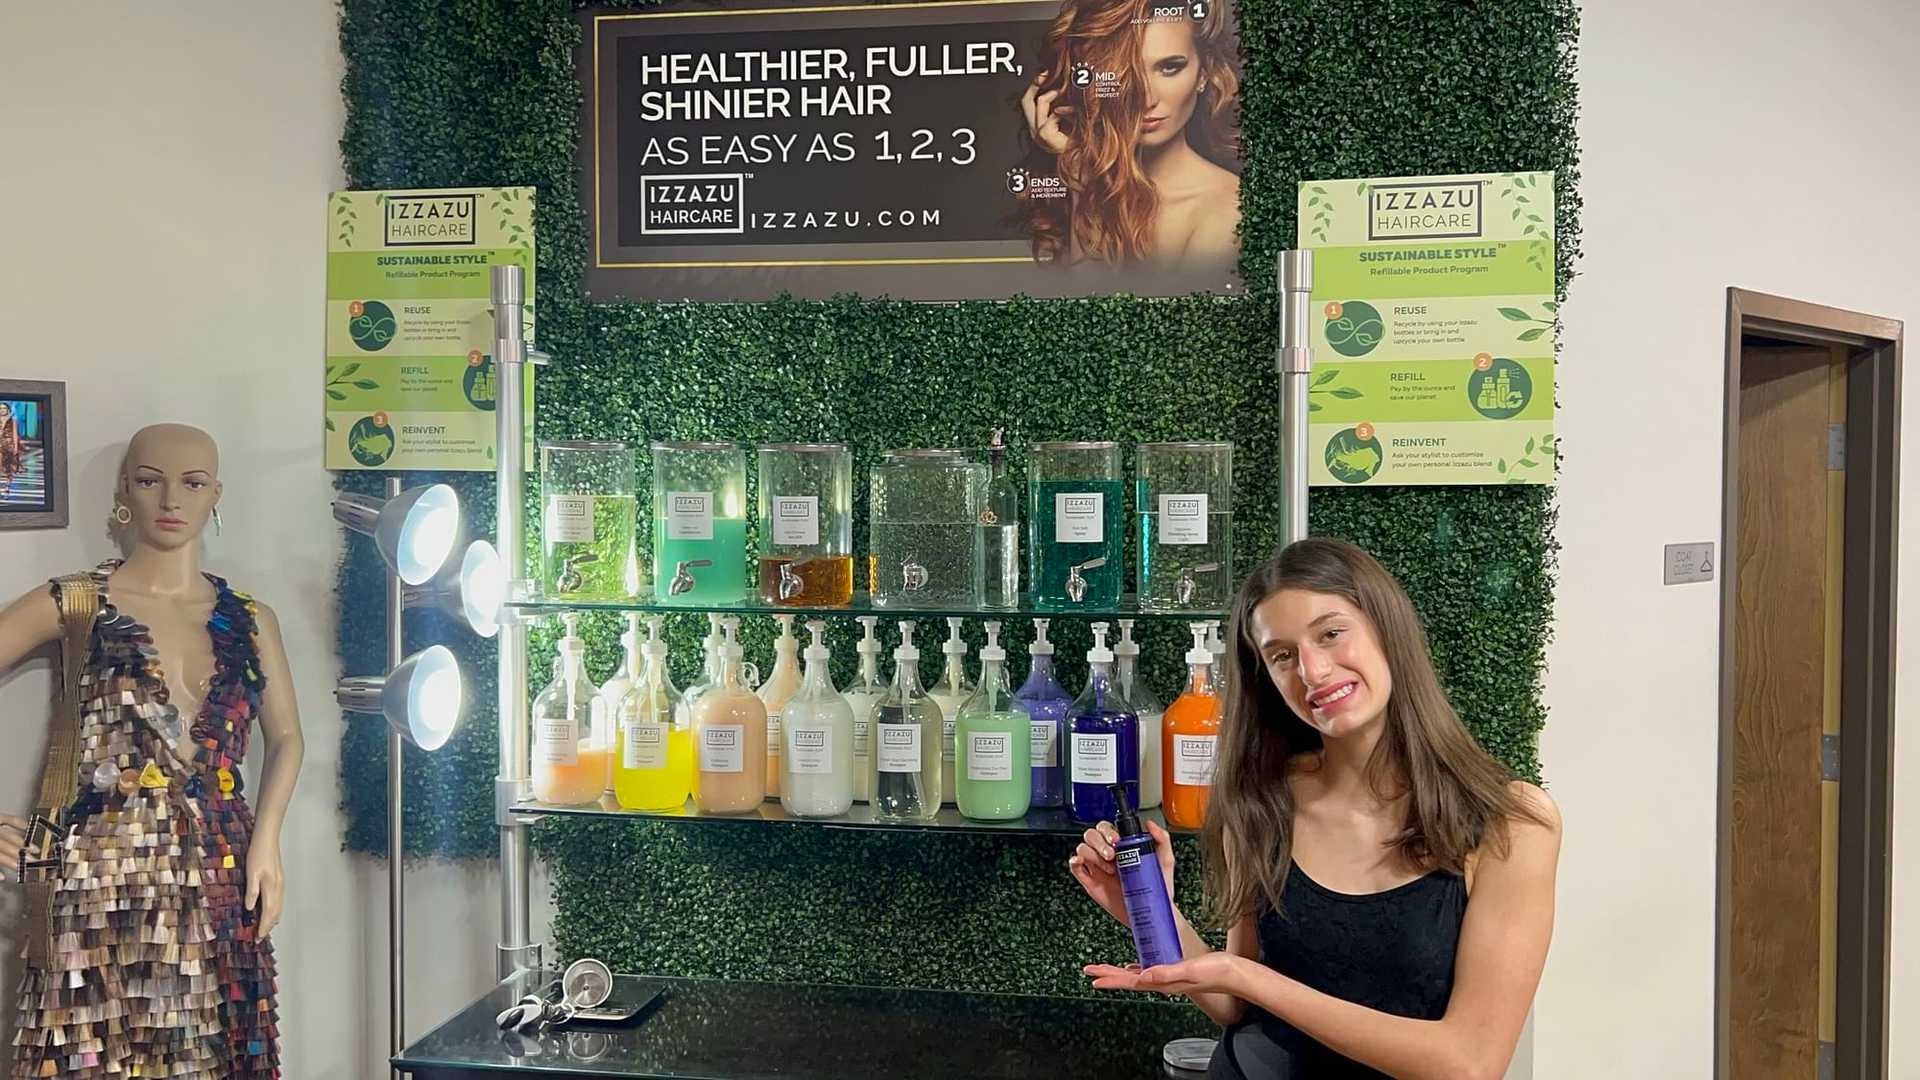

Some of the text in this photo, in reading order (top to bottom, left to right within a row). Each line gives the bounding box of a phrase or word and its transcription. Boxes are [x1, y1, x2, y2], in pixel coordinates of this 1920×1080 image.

[1154, 7, 1184, 17] ROOT
[1193, 3, 1205, 18] 1
[641, 42, 1023, 86] HEALTHIER, FULLER,
[1076, 69, 1116, 85] 2 MID
[641, 84, 892, 122] SHINIER HAIR
[640, 136, 689, 166] AS
[701, 133, 797, 164] EASY
[805, 132, 856, 163] AS
[1012, 174, 1060, 192] 3 ENDS
[650, 184, 734, 203] IZZAZU
[1376, 189, 1474, 211] IZZAZU
[391, 201, 469, 219] IZZAZU
[650, 209, 733, 224] HAIRCARE
[751, 209, 941, 229] IZZAZU.COM
[1377, 213, 1472, 230] HAIRCARE
[391, 223, 467, 237] HAIRCARE
[377, 256, 453, 266] SUSTAINABLE
[453, 255, 488, 264] STYLE
[1359, 249, 1452, 262] SUSTAINABLE
[1454, 247, 1497, 259] STYLE
[1370, 265, 1489, 276] Refillable Product Program
[404, 306, 431, 314] REUSE
[1394, 306, 1427, 315] REUSE
[1479, 358, 1489, 367] 2
[1390, 373, 1426, 381] REFILL
[402, 426, 445, 434] REINVENT
[1392, 438, 1446, 447] REINVENT
